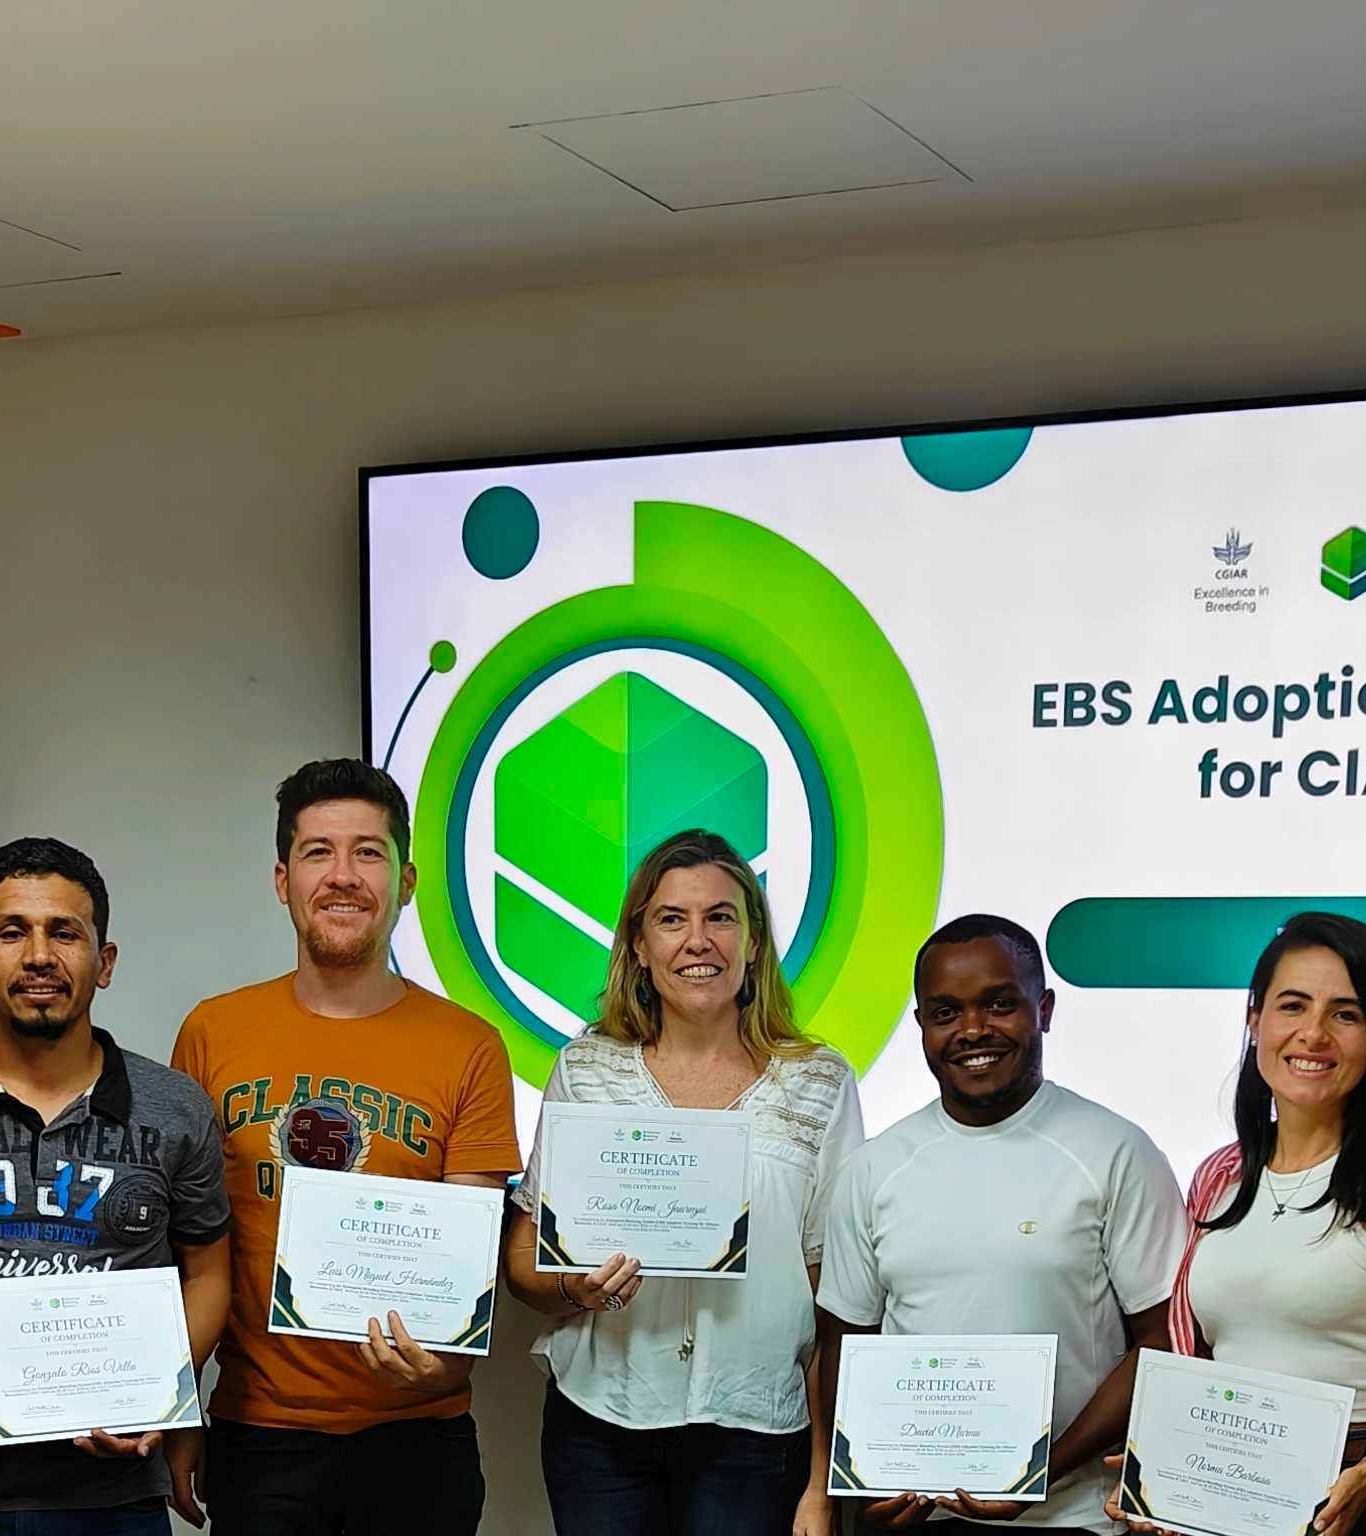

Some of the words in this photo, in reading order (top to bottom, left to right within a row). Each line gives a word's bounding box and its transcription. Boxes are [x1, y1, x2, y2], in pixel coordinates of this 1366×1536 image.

[1214, 568, 1249, 580] CGIAR
[1194, 586, 1256, 600] Excellence
[1258, 585, 1270, 597] in
[1205, 599, 1257, 613] Breeding
[1033, 680, 1133, 728] EBS
[1197, 747, 1283, 799] for
[222, 1073, 433, 1157] CLASSIC
[58, 1119, 162, 1167] WEAR
[600, 1151, 698, 1167] CERTIFICATE
[629, 1168, 680, 1177] COMPLETION
[340, 1218, 442, 1240] CERTIFICATE
[369, 1237, 423, 1248] COMPLETION
[20, 1315, 126, 1334] CERTIFICATE
[53, 1332, 109, 1342] COMPLETION
[896, 1379, 996, 1391] CERTIFICATE
[1190, 1406, 1288, 1438] CERTIFICATE
[900, 1424, 936, 1437] David
[1217, 1428, 1268, 1445] COMPLETION
